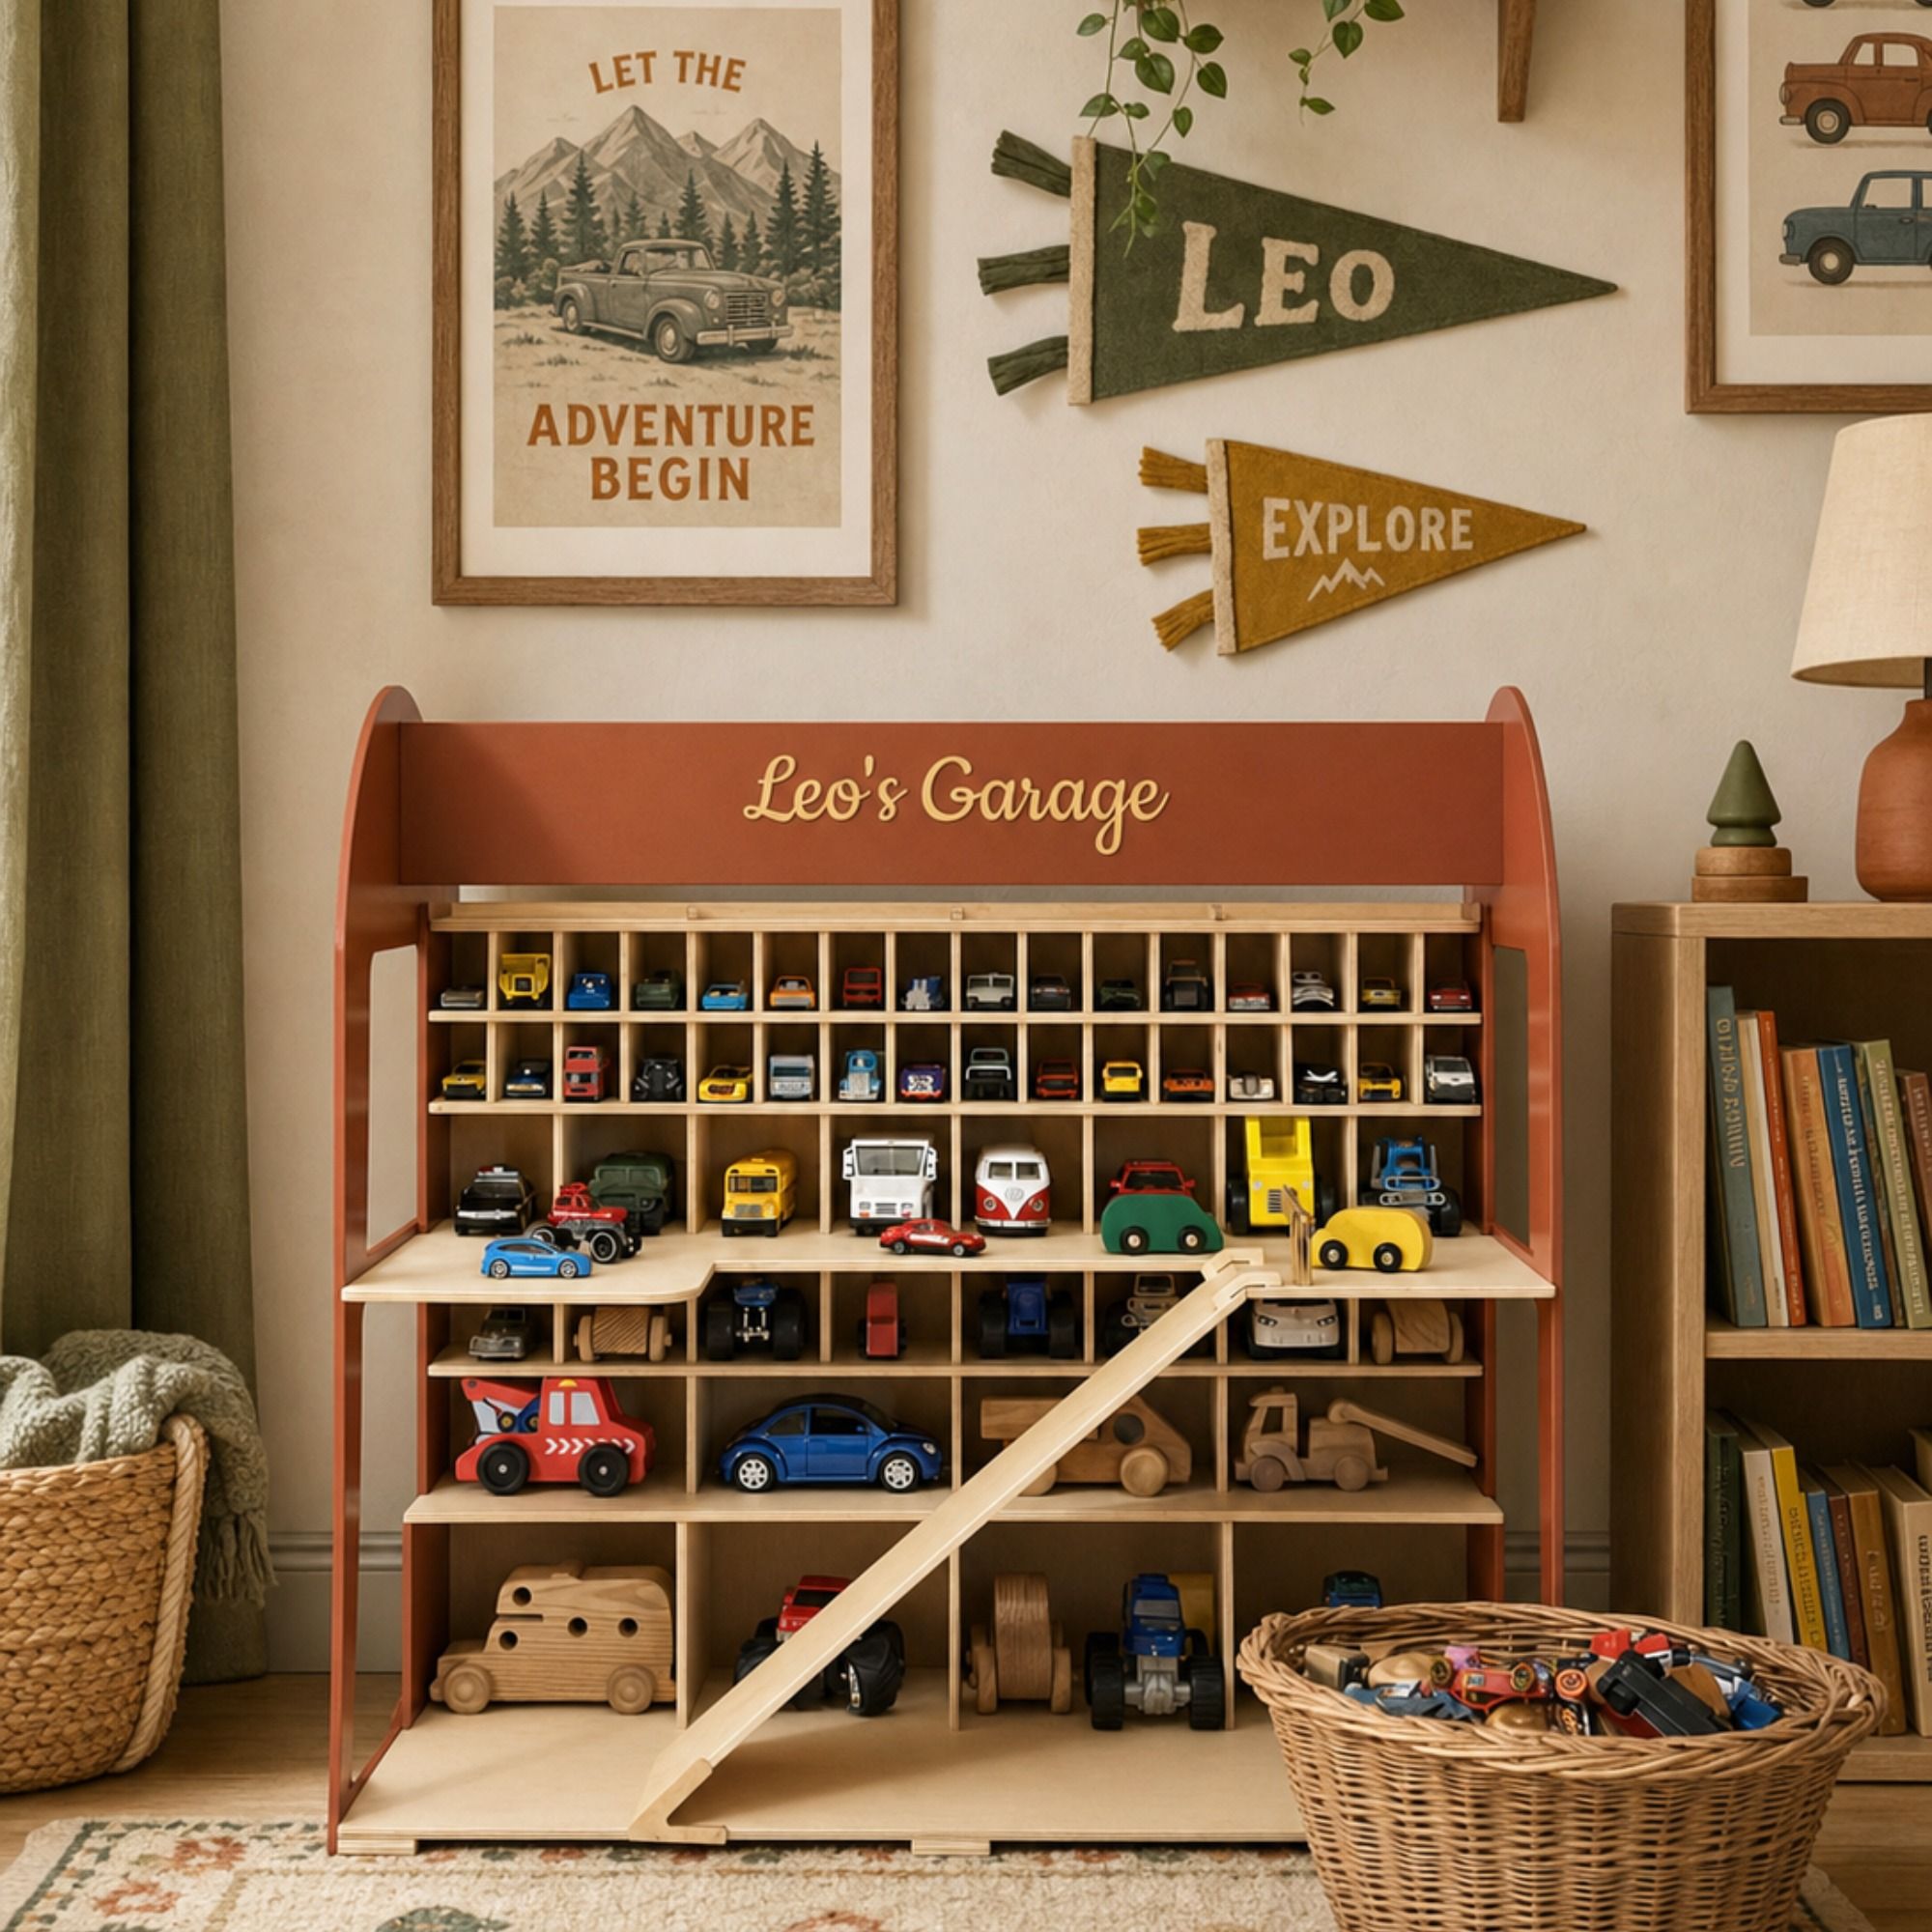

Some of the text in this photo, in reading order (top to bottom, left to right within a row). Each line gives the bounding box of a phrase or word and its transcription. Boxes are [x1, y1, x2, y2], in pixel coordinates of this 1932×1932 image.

[590, 50, 746, 94] LET THE
[1173, 220, 1395, 332] LEO
[527, 403, 815, 447] ADVENTURE
[591, 456, 750, 501] BEGIN
[1262, 497, 1474, 559] EXPLORE
[743, 754, 1170, 856] Leo's Garage
